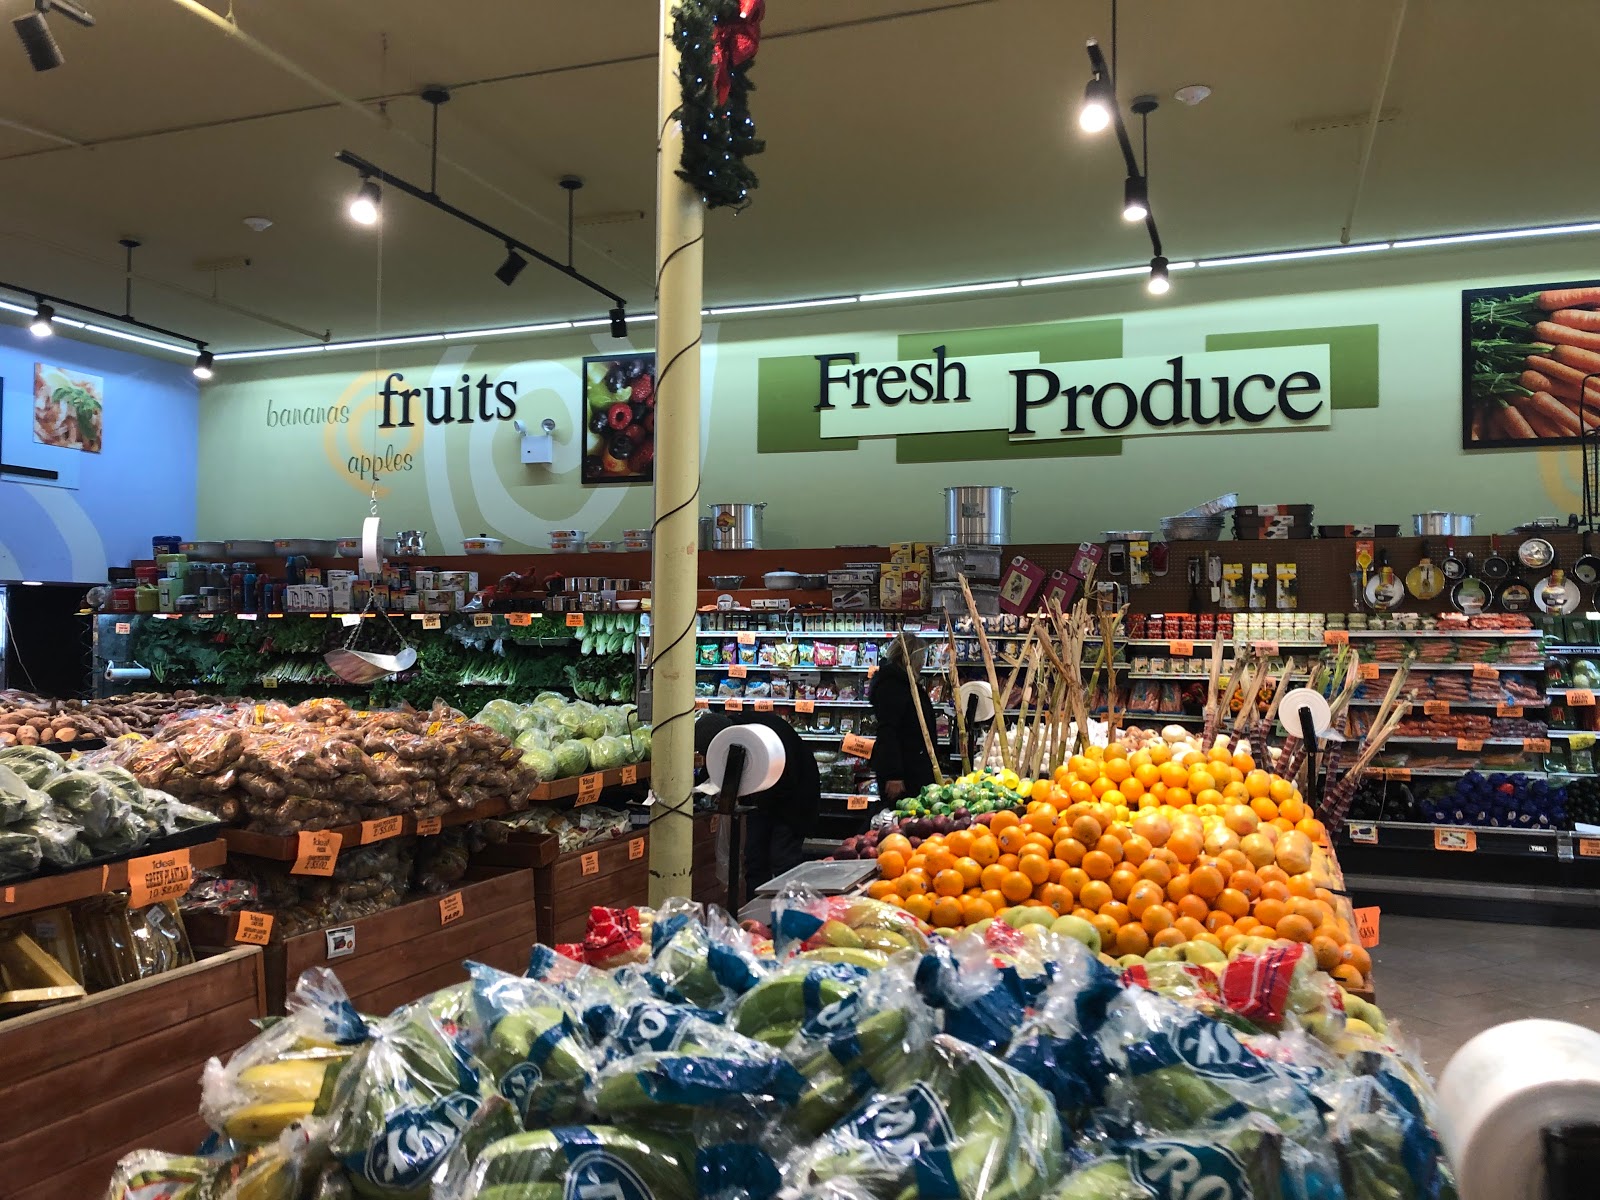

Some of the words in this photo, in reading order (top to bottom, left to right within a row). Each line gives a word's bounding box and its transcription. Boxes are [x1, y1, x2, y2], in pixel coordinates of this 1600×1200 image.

[378, 372, 518, 428] fruits
[813, 344, 970, 410] Fresh
[1008, 356, 1324, 434] Produce
[266, 400, 350, 428] bananas
[347, 444, 413, 479] apples
[145, 870, 164, 888] GREEN
[152, 857, 176, 870] Ideal
